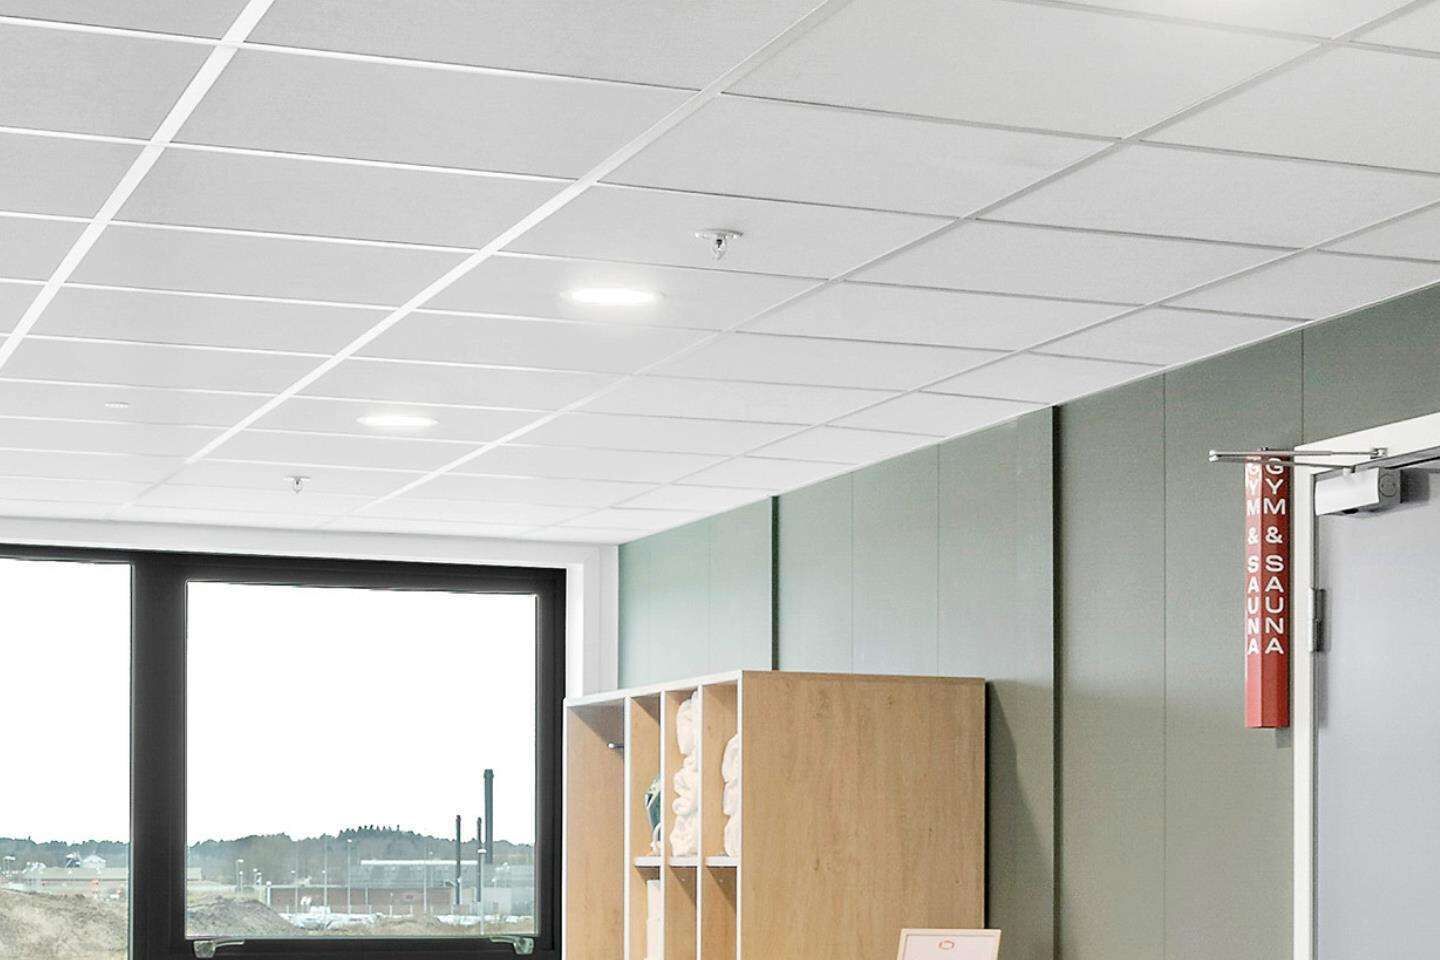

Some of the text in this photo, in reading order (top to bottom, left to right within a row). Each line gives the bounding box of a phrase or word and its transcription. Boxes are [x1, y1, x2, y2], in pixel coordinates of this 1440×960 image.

[1247, 527, 1259, 544] &
[1263, 458, 1286, 655] GYM & SAUNA
[1247, 555, 1260, 655] SAUNA
